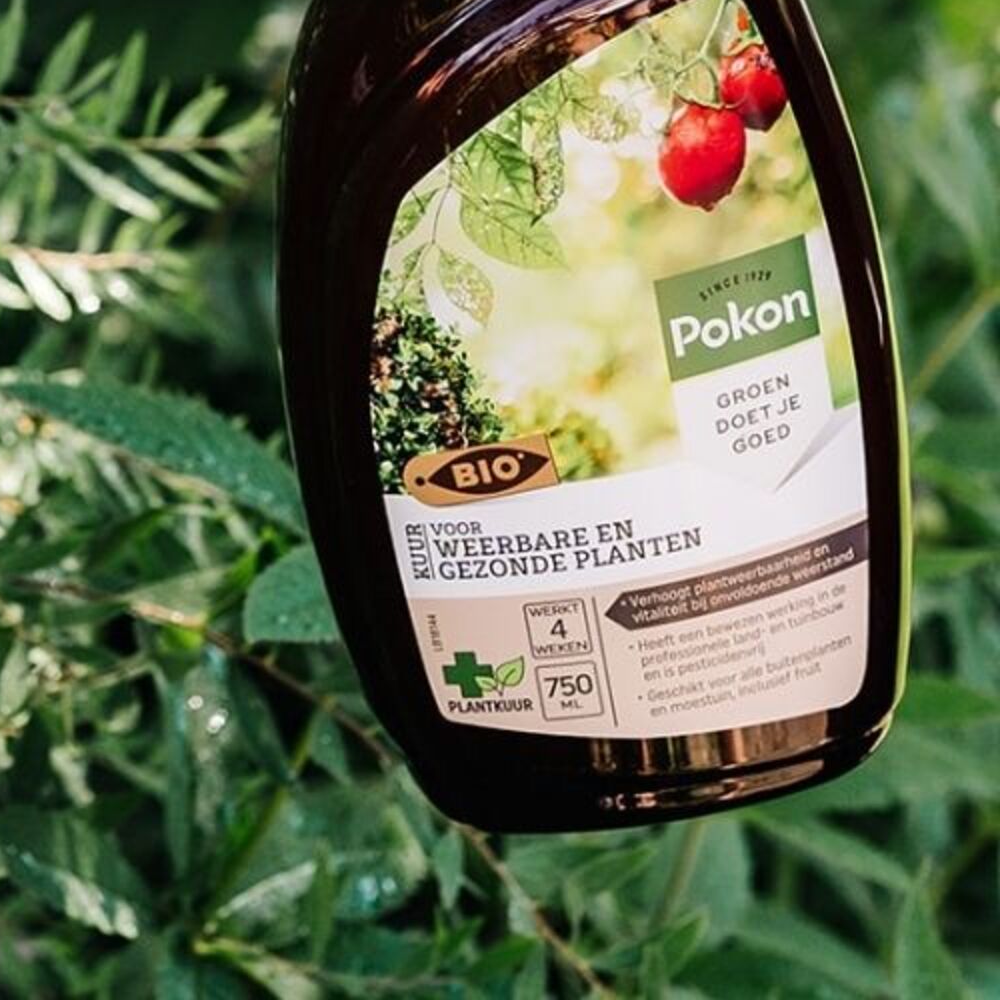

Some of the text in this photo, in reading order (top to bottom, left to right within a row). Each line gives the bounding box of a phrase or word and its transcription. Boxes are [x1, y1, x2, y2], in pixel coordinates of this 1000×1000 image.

[699, 274, 739, 302] SINCE
[669, 289, 812, 359] Pokon
[716, 373, 791, 409] GROEN
[715, 393, 802, 434] DOET JE
[732, 423, 791, 454] GOED
[452, 454, 521, 489] BIO
[430, 521, 483, 536] VOOR
[434, 519, 635, 559] WEERBARE EN
[405, 522, 431, 580] KUUR
[438, 527, 702, 581] GEZONDE PLANTEN
[629, 543, 830, 608] Verhoogt plantweerbaarheid en
[631, 547, 855, 624] vitaliteit bij onvoldoende weerstand
[529, 603, 580, 617] WERKT
[638, 635, 675, 651] Heeft
[679, 630, 704, 643] een
[832, 584, 846, 597] de
[550, 619, 567, 639] 4
[534, 640, 588, 655] WEKEN
[544, 674, 593, 698] 750
[643, 670, 662, 681] en
[448, 699, 534, 713] PLANTKUUR
[561, 700, 584, 709] ML
[650, 705, 668, 717] en
